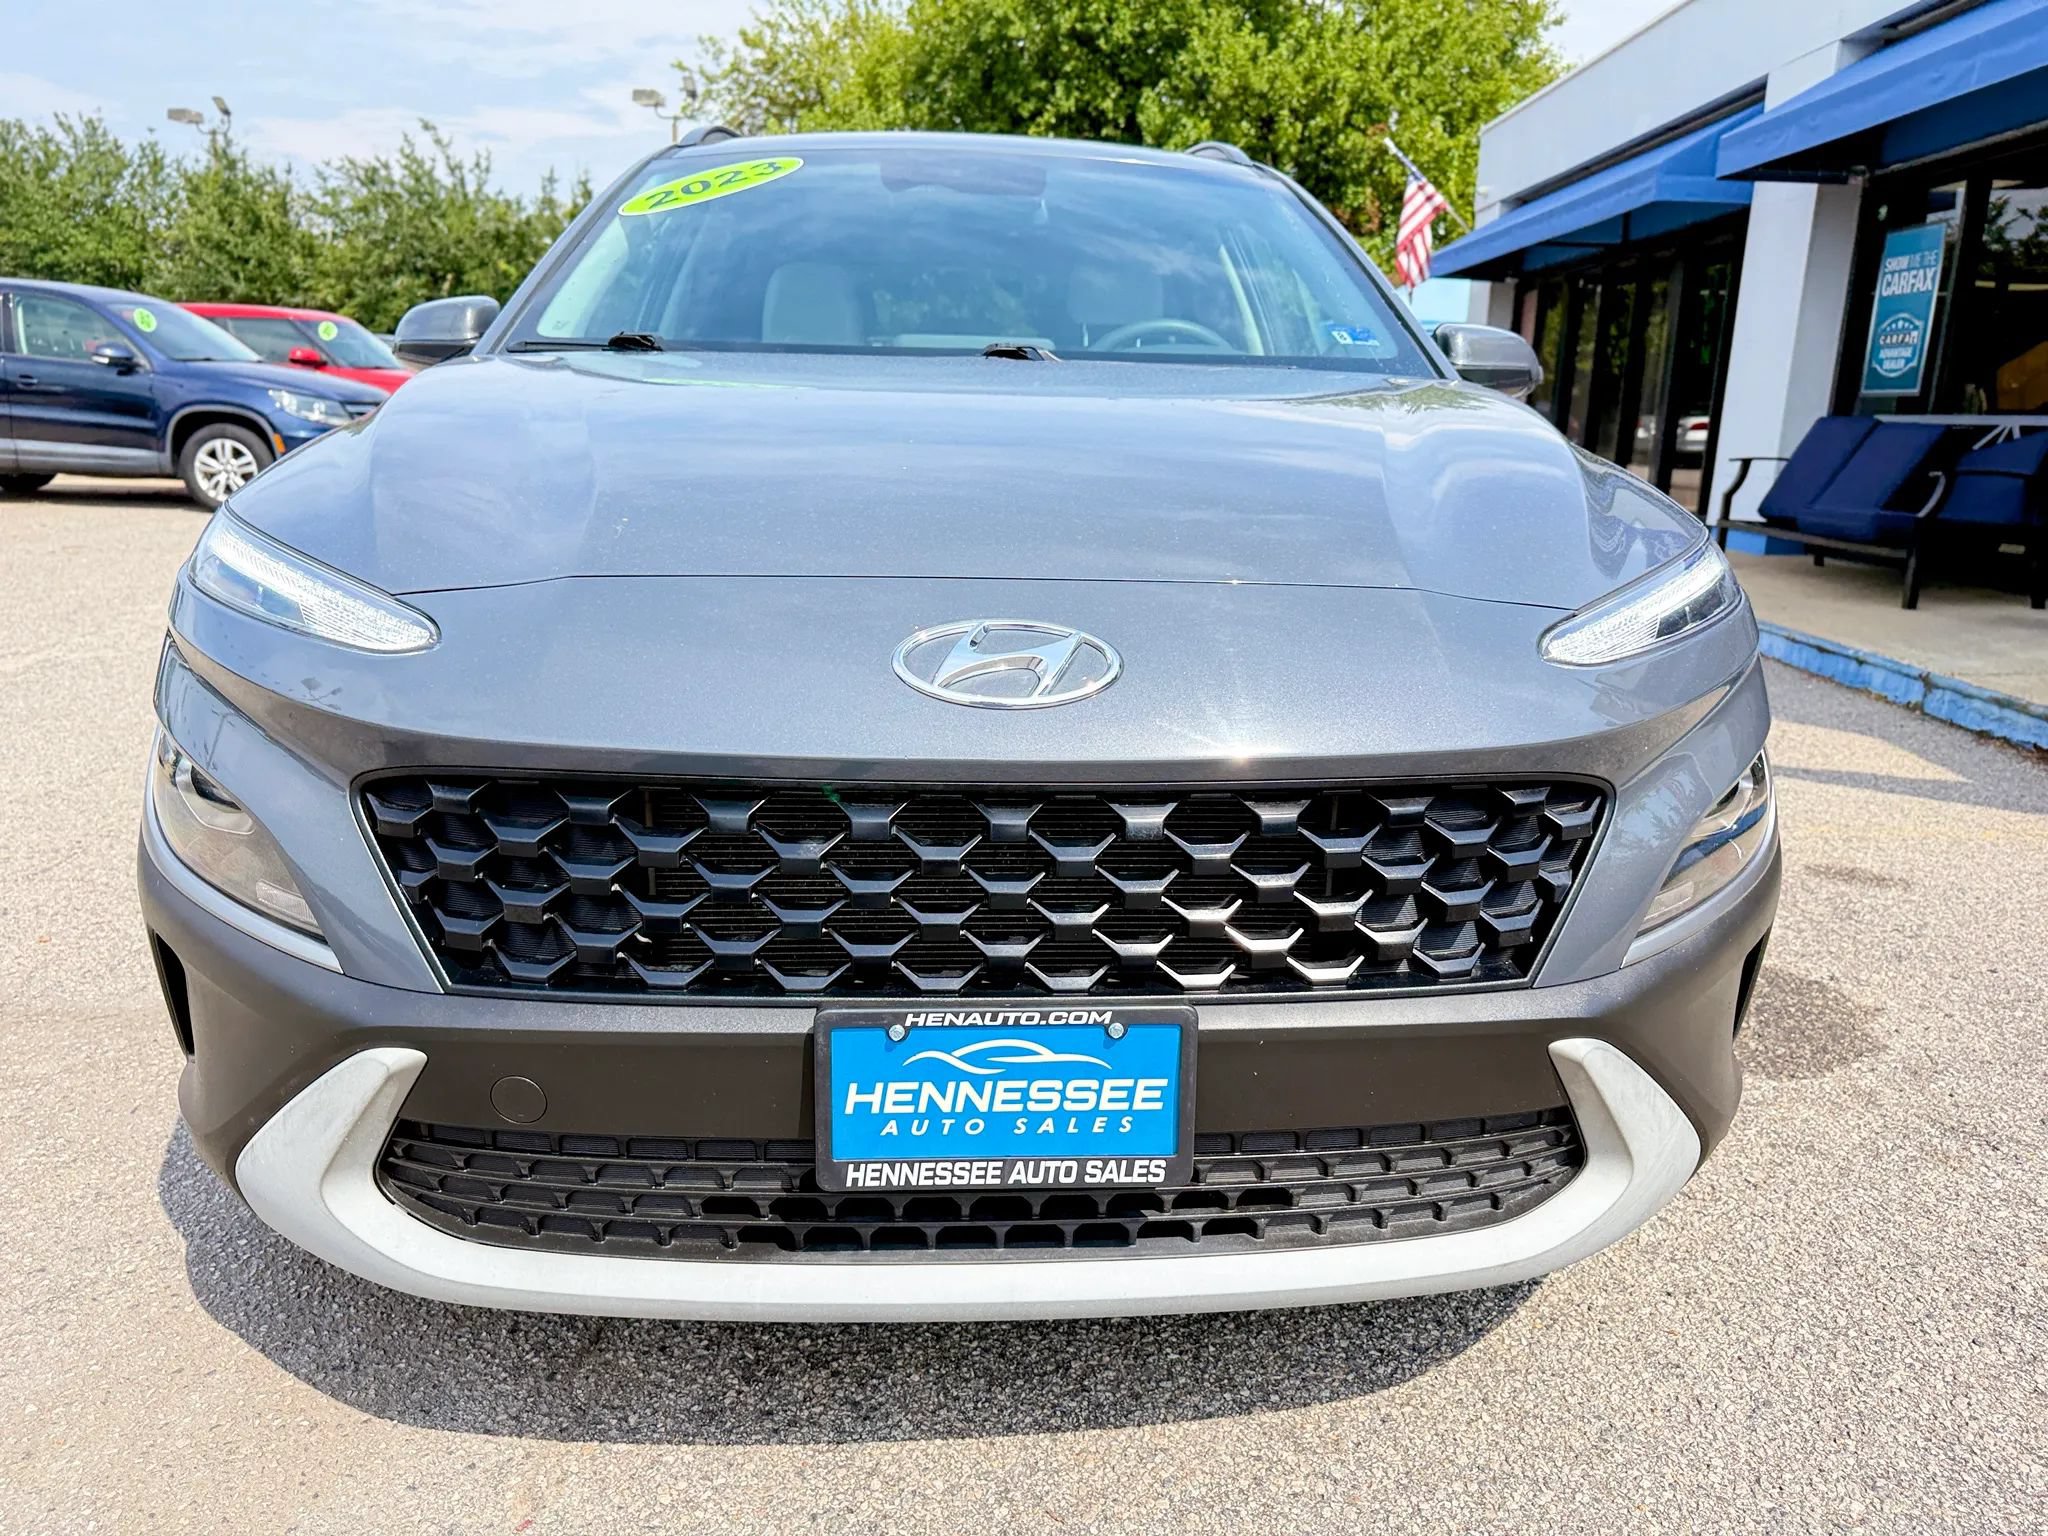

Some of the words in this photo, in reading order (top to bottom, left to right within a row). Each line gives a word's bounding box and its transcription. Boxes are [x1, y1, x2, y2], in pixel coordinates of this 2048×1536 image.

[645, 161, 786, 210] 2023
[1884, 256, 1910, 272] SHOW
[1881, 267, 1937, 297] CARFAX
[904, 1010, 1114, 1028] HENAUTO.COM
[844, 1078, 1169, 1115] HENNESSEE
[880, 1118, 986, 1137] AUTO
[1013, 1116, 1134, 1134] SALES
[846, 1161, 1003, 1188] HENNESSEE
[1007, 1160, 1079, 1185] AUTO
[1084, 1159, 1167, 1184] SALES
